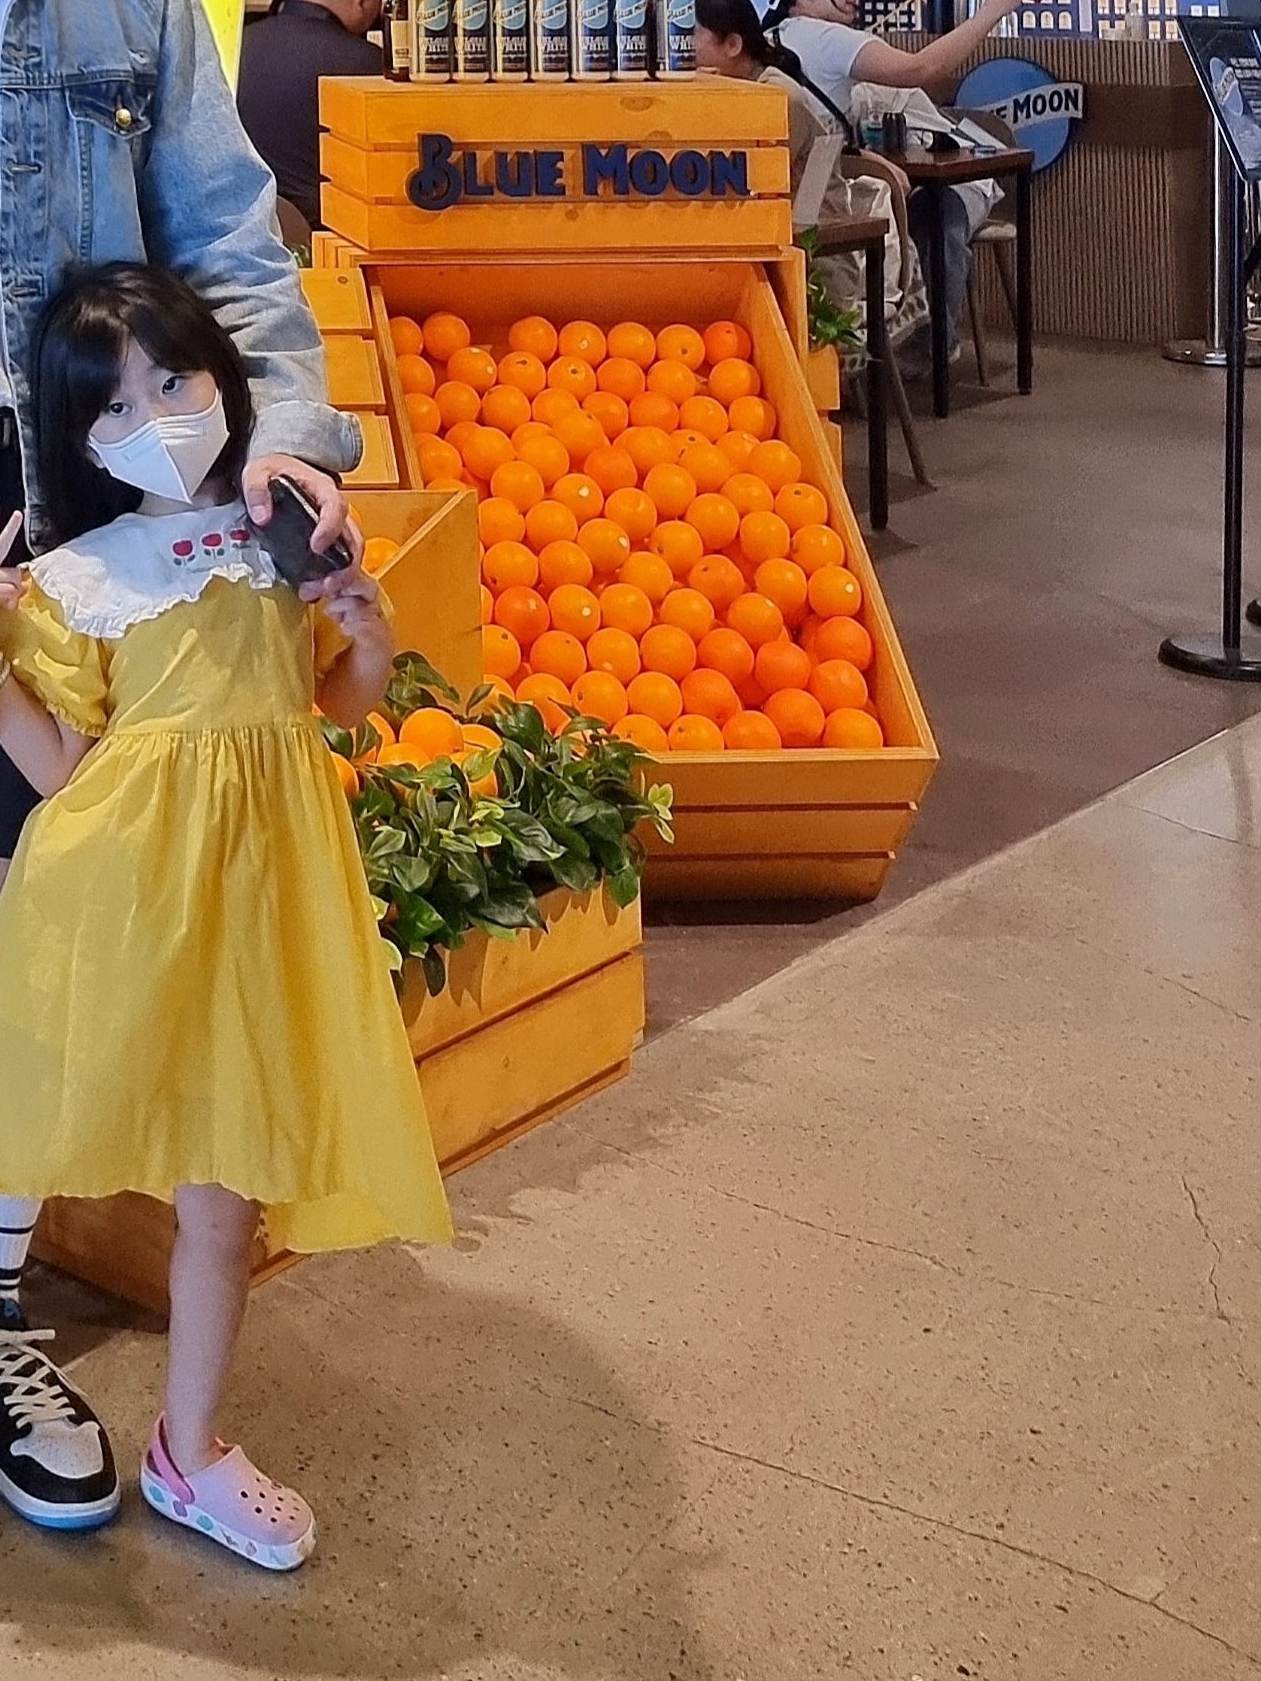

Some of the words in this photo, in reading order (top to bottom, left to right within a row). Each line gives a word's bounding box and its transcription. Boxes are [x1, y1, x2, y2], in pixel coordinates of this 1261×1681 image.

[1012, 87, 1080, 125] MOON
[408, 133, 566, 211] BLUE
[581, 143, 750, 197] MOON
